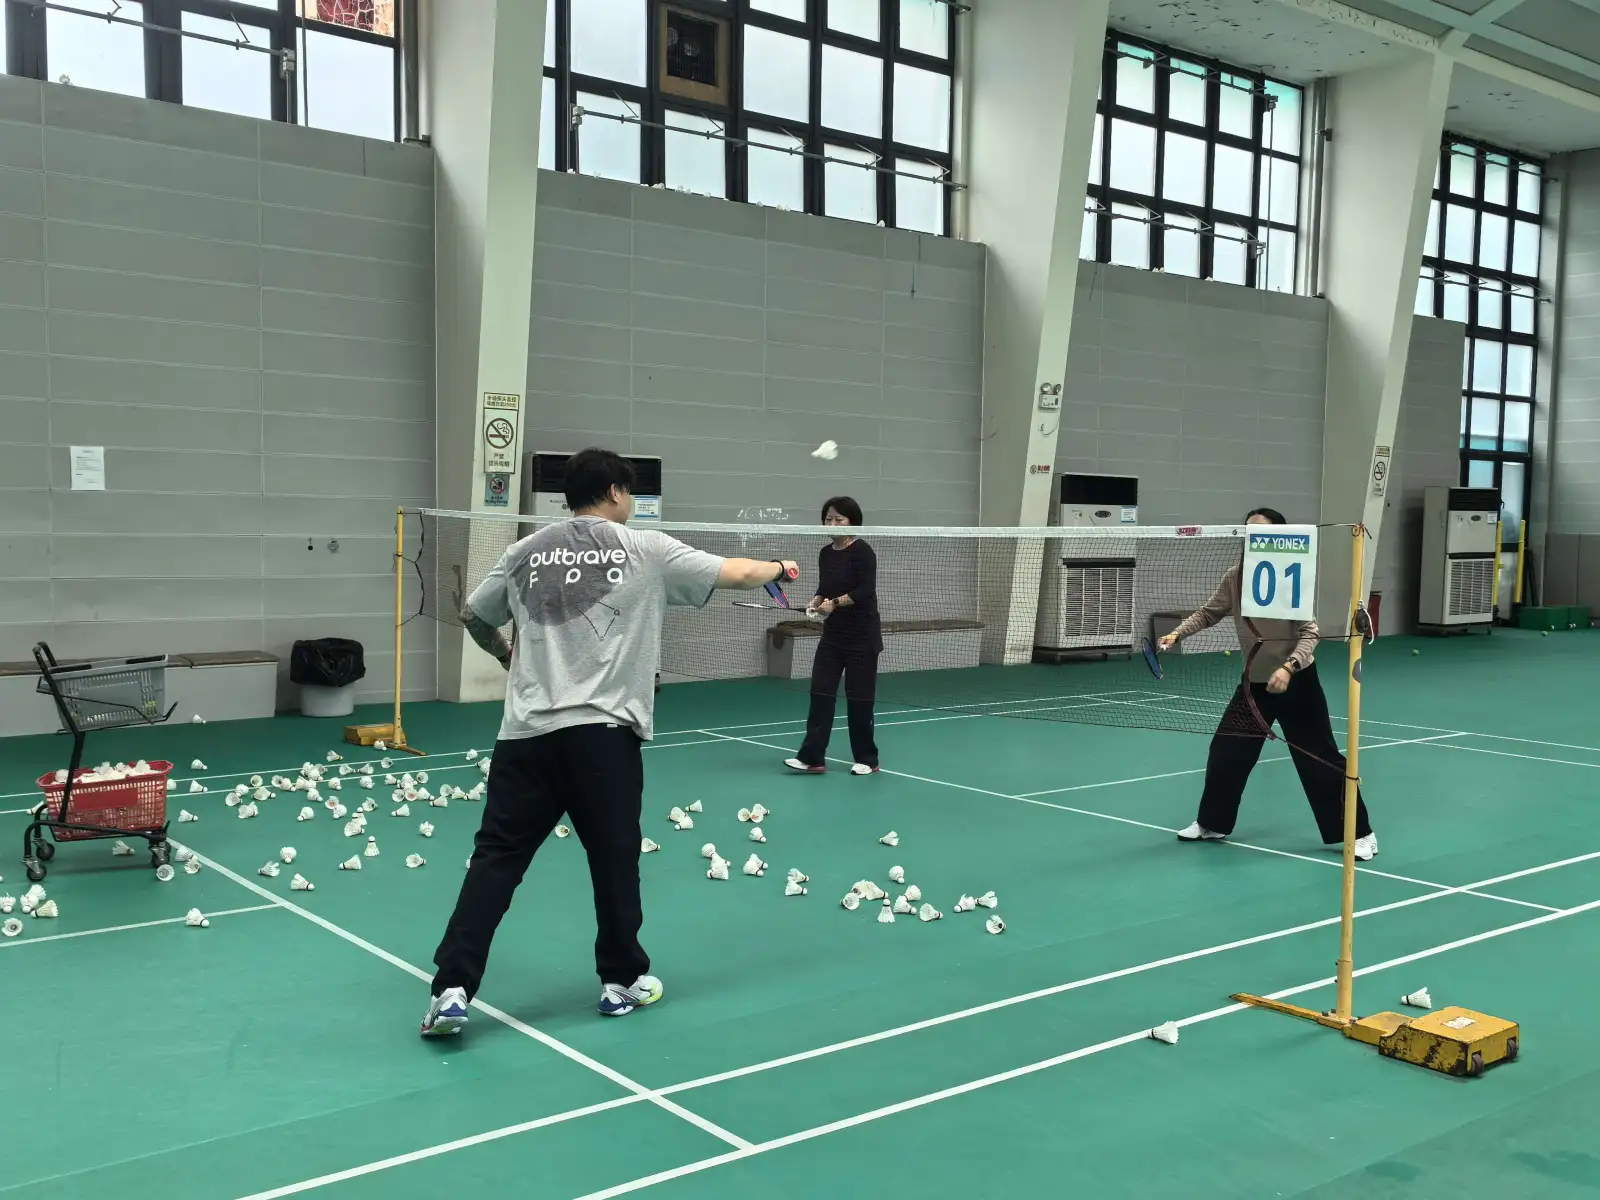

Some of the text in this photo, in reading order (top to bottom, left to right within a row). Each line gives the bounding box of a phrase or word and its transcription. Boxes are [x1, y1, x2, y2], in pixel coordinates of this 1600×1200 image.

[1272, 537, 1305, 550] YONEX
[529, 547, 627, 568] outbrave
[1252, 560, 1301, 608] 01
